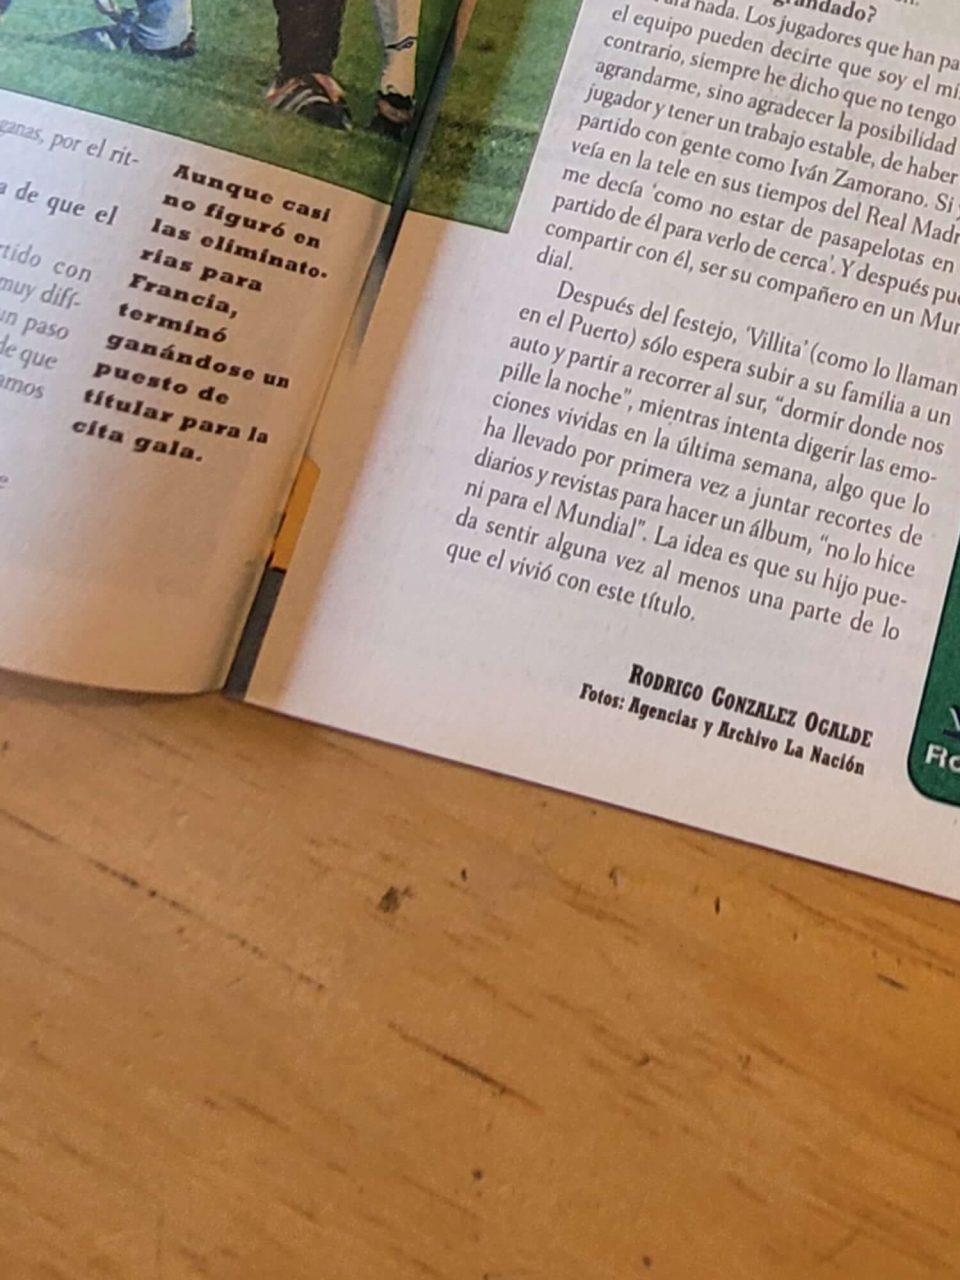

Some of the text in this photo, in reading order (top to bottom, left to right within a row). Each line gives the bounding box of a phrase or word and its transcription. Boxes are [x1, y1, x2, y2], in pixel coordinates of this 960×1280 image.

[48, 133, 82, 152] por
[86, 138, 107, 158] el
[15, 181, 118, 225] de que el
[172, 163, 332, 224] Aunque casi
[150, 217, 192, 242] las
[161, 193, 322, 251] no figuró en
[53, 261, 92, 282] con
[139, 248, 264, 294] rias para
[128, 272, 239, 321] Francia,
[21, 316, 70, 340] paso
[117, 302, 228, 344] terminó
[20, 347, 58, 369] que
[105, 333, 291, 390] ganándose un
[92, 361, 230, 406] puesto de
[83, 388, 269, 445] titular para la
[71, 419, 204, 463] cita gala.
[445, 542, 696, 622] que el vivió con este título.
[627, 662, 875, 749] RODRIGO GONZALEZ OGALDE
[578, 681, 866, 777] Fotos: Agencias y Archivo La Nación
